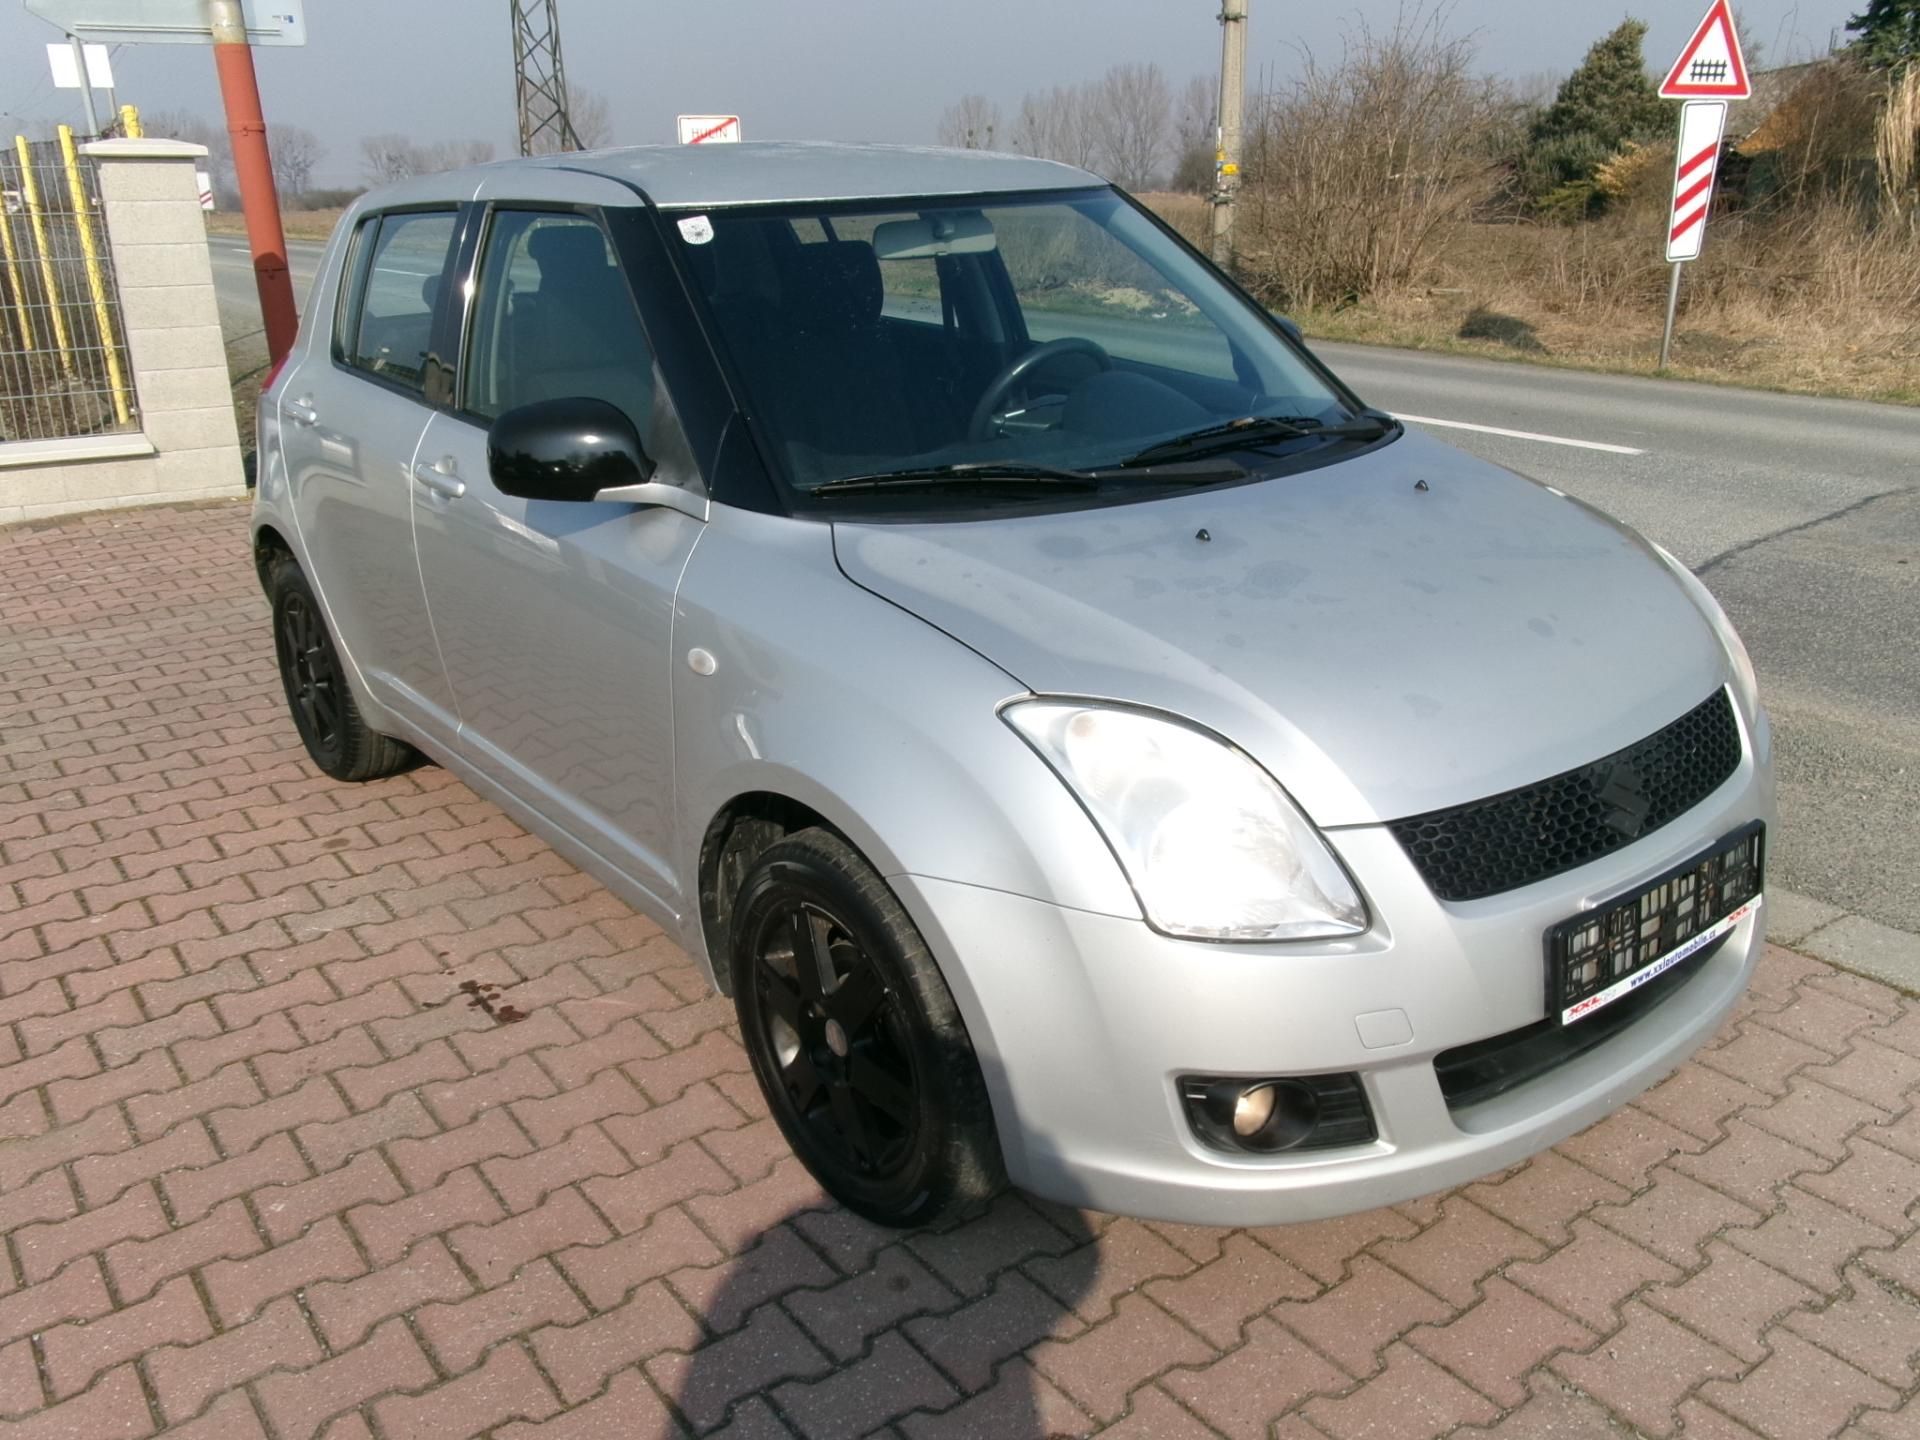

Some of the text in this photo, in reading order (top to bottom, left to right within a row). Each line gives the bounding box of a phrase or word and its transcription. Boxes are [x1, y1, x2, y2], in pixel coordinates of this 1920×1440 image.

[1727, 905, 1749, 922] XXL
[1630, 929, 1716, 988] www.xxlautomobile.cz
[1568, 995, 1601, 1014] XXL
